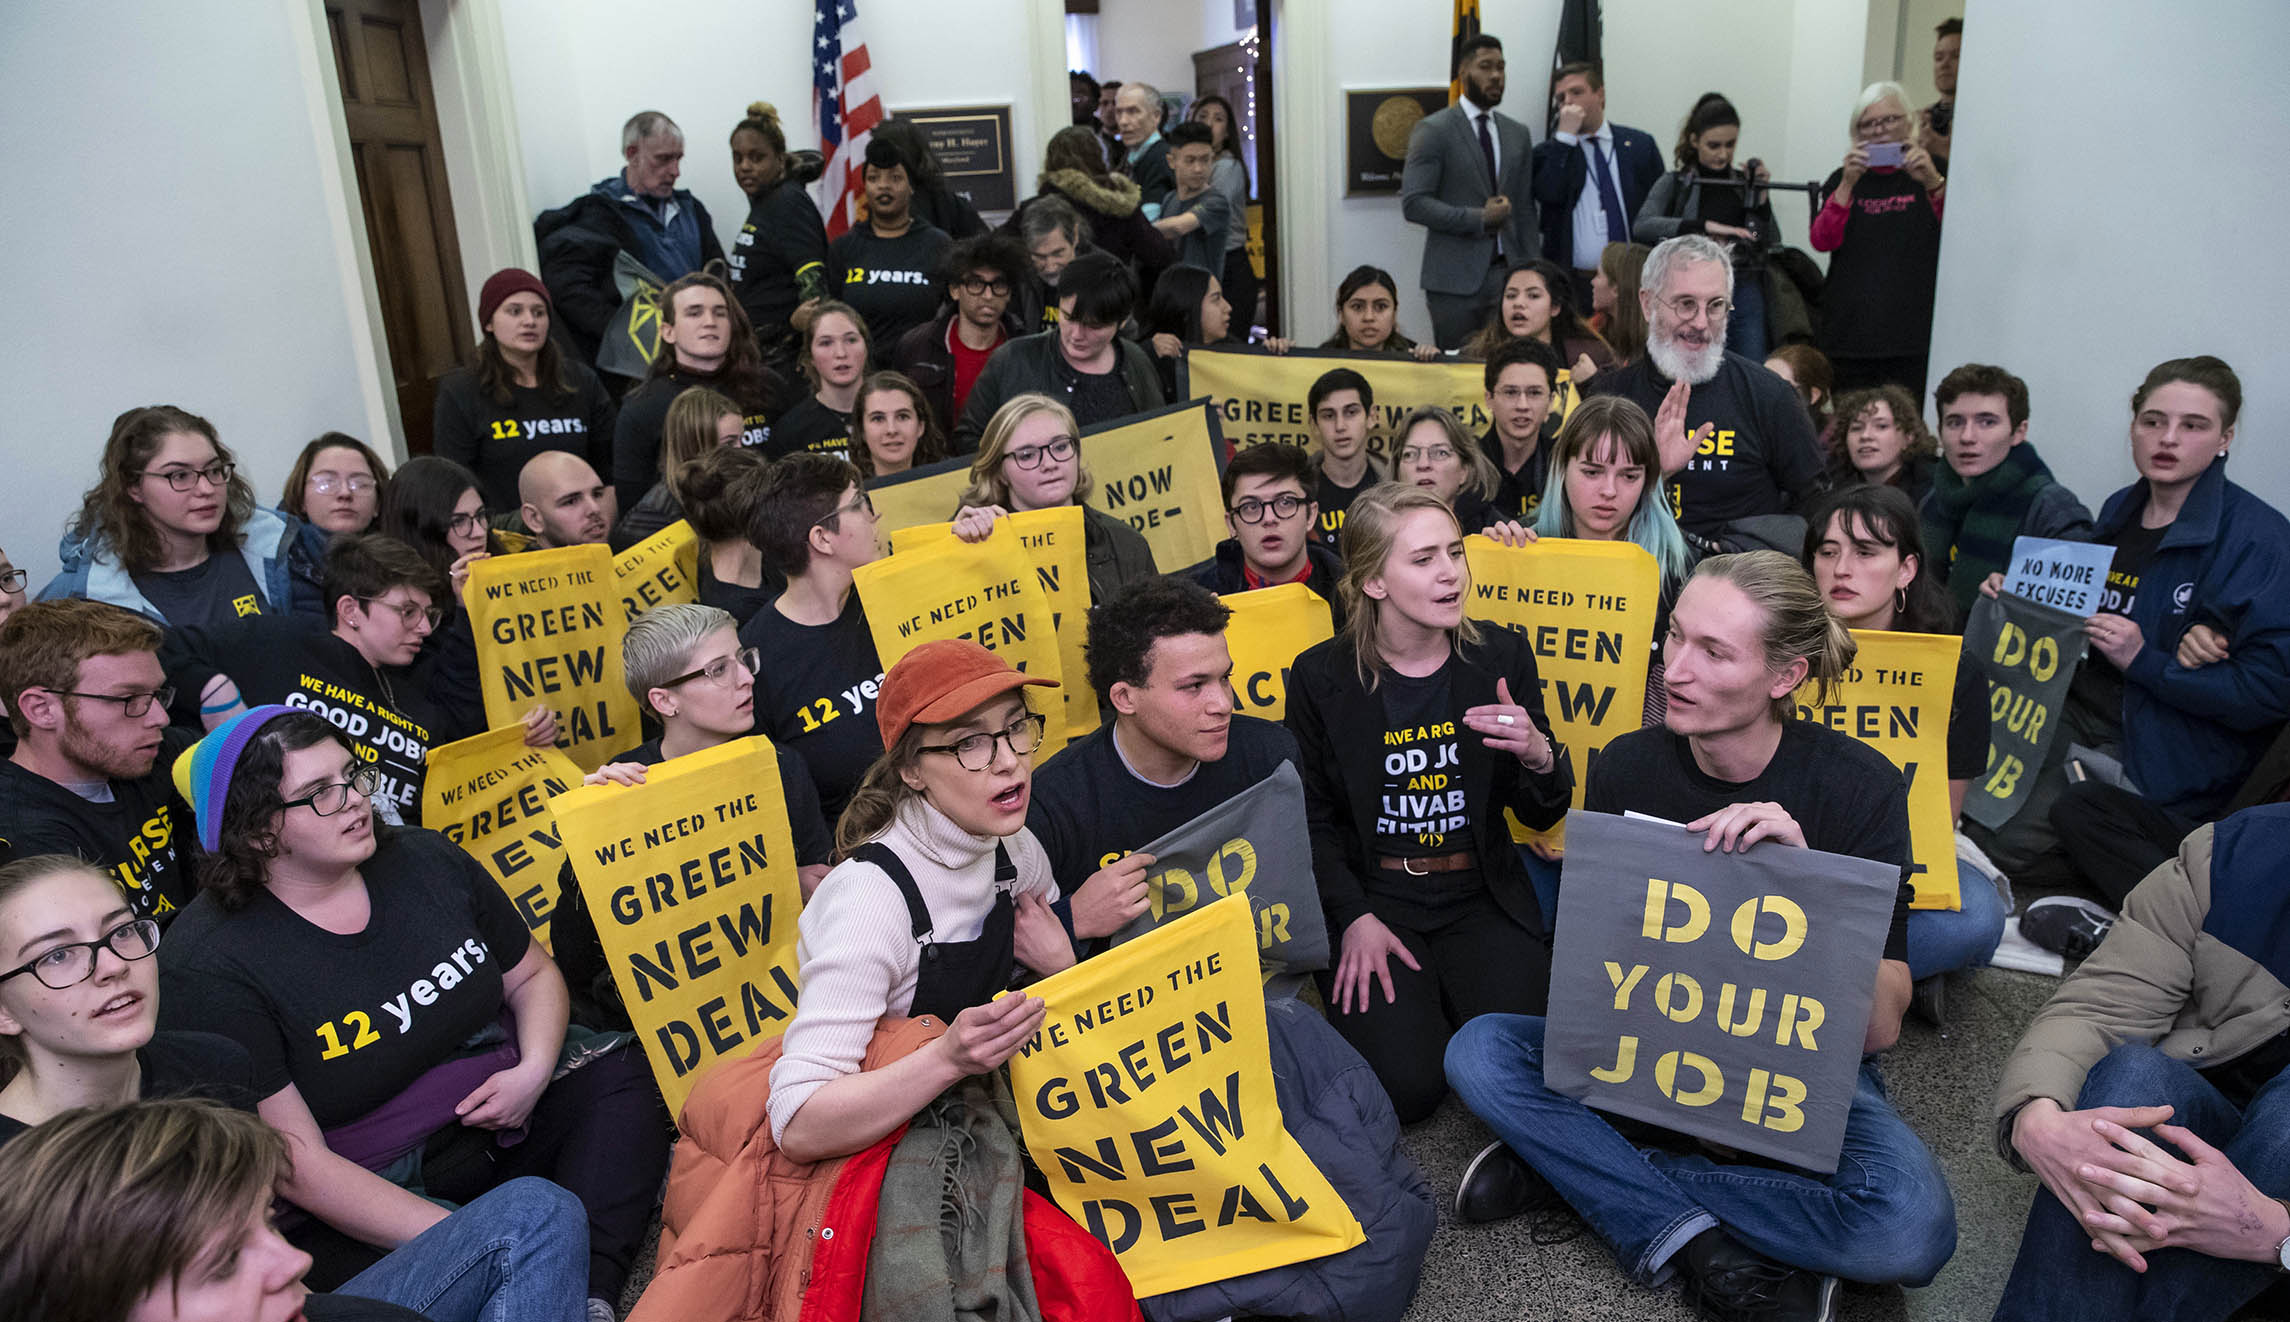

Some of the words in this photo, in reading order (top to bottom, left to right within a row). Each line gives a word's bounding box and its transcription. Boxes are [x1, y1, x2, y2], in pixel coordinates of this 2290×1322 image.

[845, 268, 864, 284] 12
[867, 268, 929, 285] years.
[491, 420, 520, 440] 12
[522, 418, 588, 440] years.
[1223, 398, 1303, 424] GREE
[742, 427, 771, 446] OBS
[1105, 465, 1172, 510] NOW
[1020, 532, 1056, 549] THE
[486, 583, 512, 600] WE
[519, 577, 558, 597] NEED
[567, 570, 595, 586] THE
[2022, 558, 2044, 577] NO
[2049, 561, 2095, 585] MORE
[898, 616, 923, 638] WE
[930, 595, 978, 625] NEED
[983, 579, 1022, 602] THE
[1477, 584, 1509, 600] WE
[1517, 588, 1575, 607] NEED
[1586, 594, 1627, 612] THE
[2015, 581, 2088, 610] EXCUSES
[492, 601, 604, 645] GREEN
[502, 646, 605, 701] NEW
[1994, 621, 2060, 683] DO
[1876, 669, 1924, 687] THE
[285, 692, 369, 737] GOOD
[300, 673, 324, 694] WE
[325, 684, 365, 709] HAVE
[366, 701, 376, 713] A
[377, 705, 414, 733] RIGHT
[415, 725, 430, 742] TO
[797, 697, 841, 733] 12
[355, 742, 379, 763] ND
[1417, 726, 1429, 741] A
[441, 787, 463, 806] WE
[468, 769, 510, 796] NEED
[512, 753, 547, 772] THE
[1385, 749, 1428, 776] OD
[1407, 774, 1449, 791] AND
[441, 777, 571, 845] GREEN
[1382, 790, 1466, 819] LIVAB
[595, 837, 635, 867] WE
[644, 813, 706, 850] NEED
[714, 793, 759, 825] THE
[611, 834, 769, 927] GREEN
[1149, 838, 1258, 923] DO
[1642, 878, 1808, 961] DO
[628, 893, 774, 1003] NEW
[1019, 1023, 1070, 1059] WE
[1074, 986, 1155, 1035] NEED
[1167, 952, 1224, 991] THE
[1603, 961, 1826, 1052] YOUR
[316, 1011, 381, 1061] 12
[1036, 1001, 1233, 1120] GREEN
[1589, 1035, 1808, 1133] JOB
[1053, 1070, 1246, 1185] NEW
[1082, 1163, 1311, 1256] DEAL
